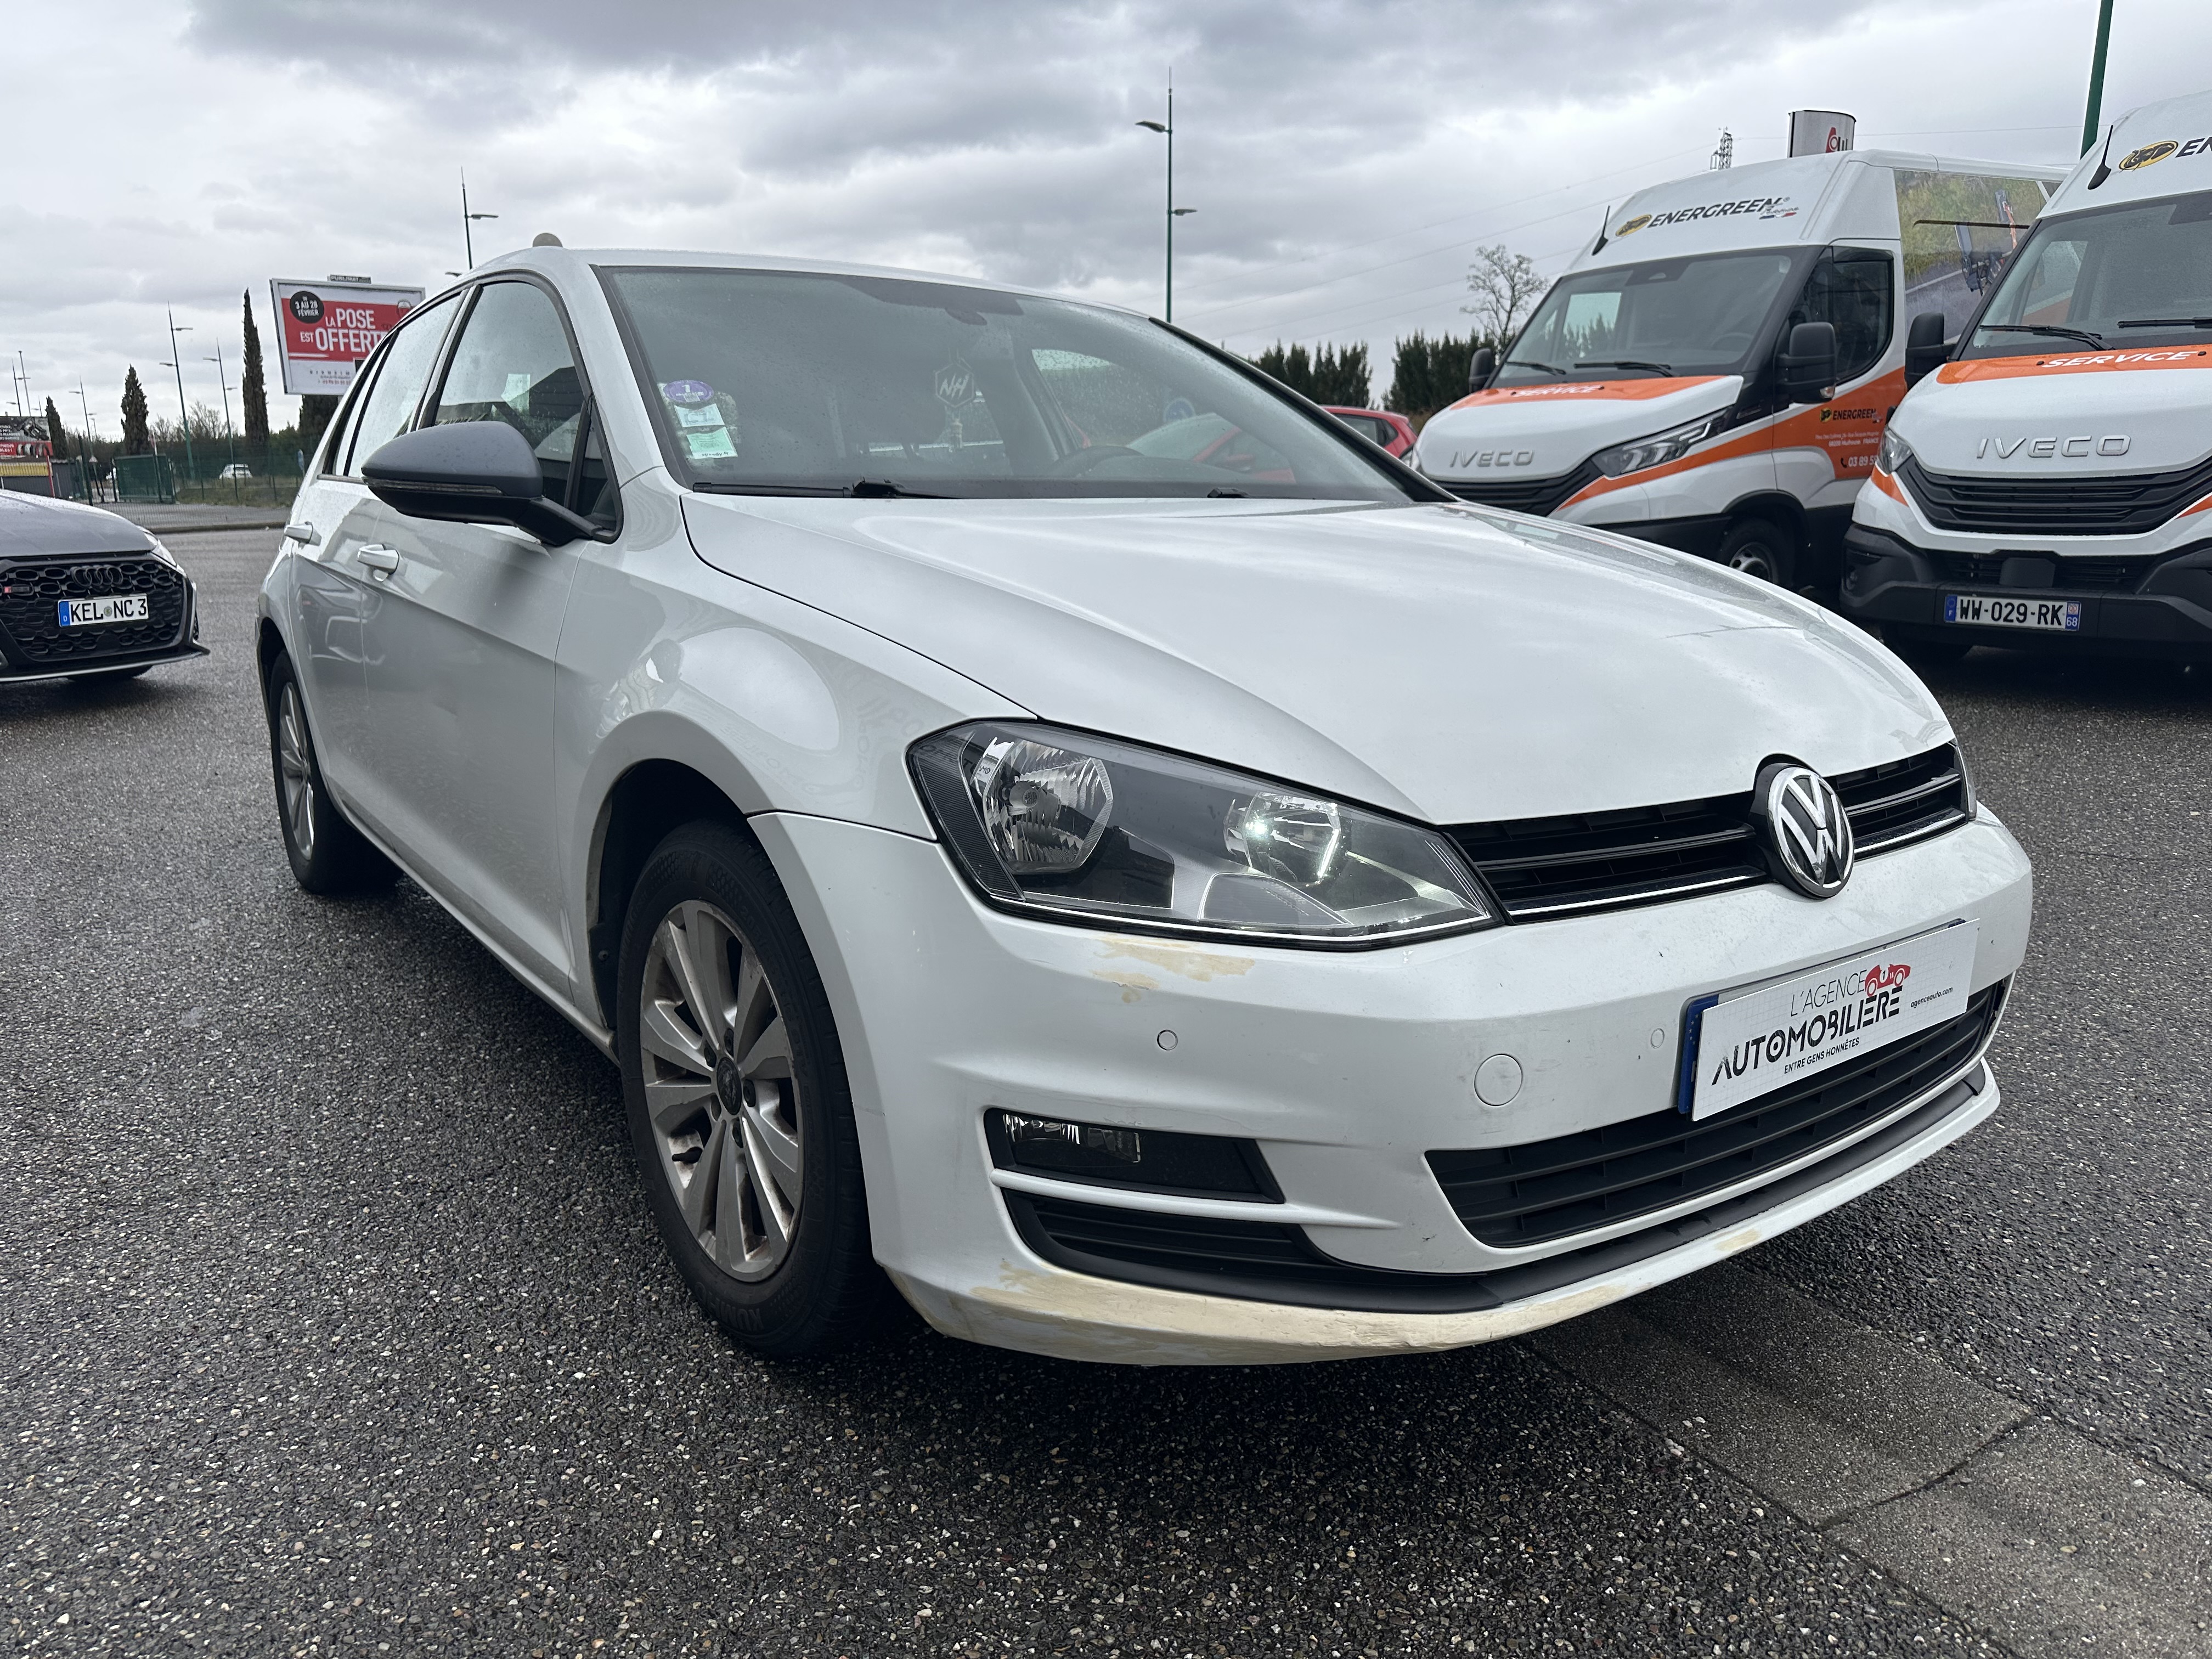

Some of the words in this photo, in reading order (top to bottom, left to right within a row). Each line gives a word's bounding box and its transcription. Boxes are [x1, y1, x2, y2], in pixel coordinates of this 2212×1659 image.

[1647, 198, 1783, 228] ENERGREEN
[301, 301, 309, 309] AU
[325, 317, 336, 327] LA
[336, 308, 376, 329] POSE
[300, 332, 313, 343] EST
[315, 328, 387, 353] OFFERT
[2042, 351, 2199, 368] SERVICE
[1513, 385, 1602, 397] SERVICE
[1833, 408, 1876, 420] ENERGREEN
[1977, 435, 2131, 459] IVECO
[1449, 449, 1535, 467] IVECO
[1848, 456, 1857, 467] 03
[70, 602, 104, 622] KEL
[114, 600, 134, 618] NC
[138, 599, 146, 616] 3
[1960, 599, 2064, 626] WW-029-RK
[2066, 617, 2078, 627] 68
[1910, 987, 1953, 1008] agenceauto.com
[1784, 1057, 1805, 1074] ENTRE
[1807, 1052, 1825, 1068] GENS
[1826, 1037, 1860, 1063] HONNÊTES
